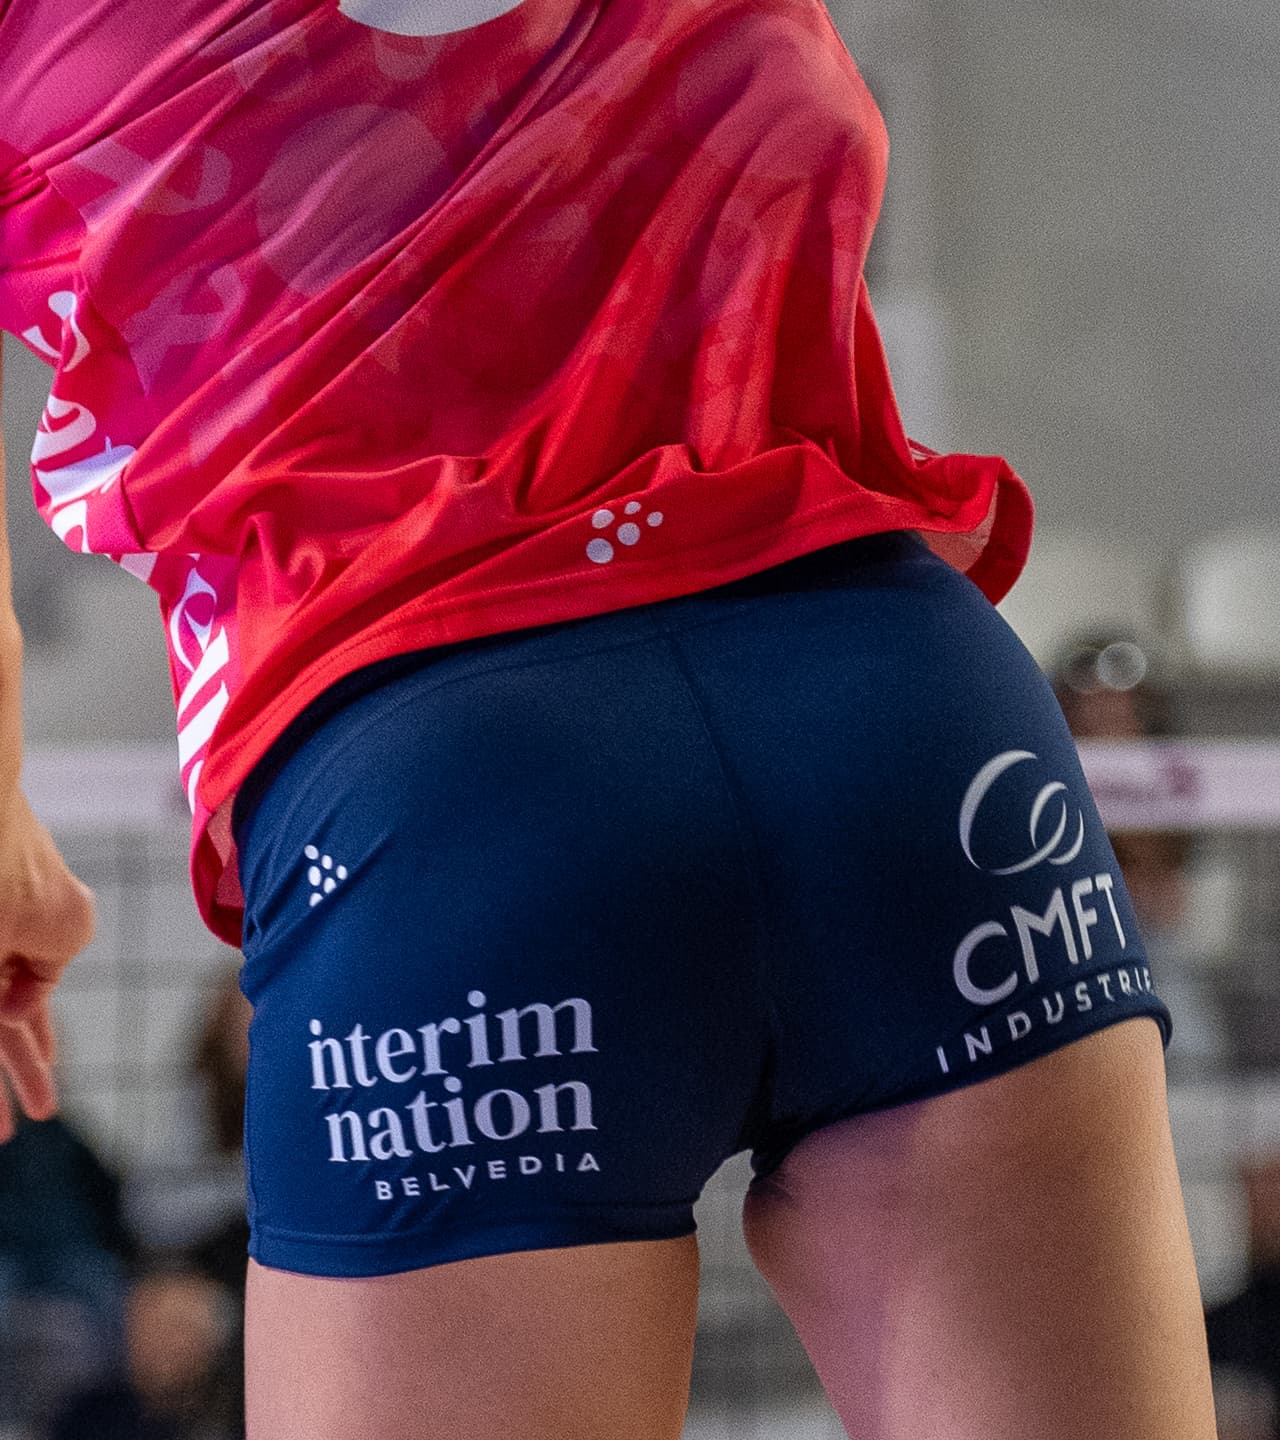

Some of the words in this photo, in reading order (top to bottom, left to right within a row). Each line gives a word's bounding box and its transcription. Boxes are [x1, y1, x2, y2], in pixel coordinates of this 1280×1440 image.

[953, 873, 1126, 1006] CMFT
[307, 990, 599, 1090] interim
[325, 1076, 599, 1162] nation
[375, 1153, 600, 1201] BELVEDIA
